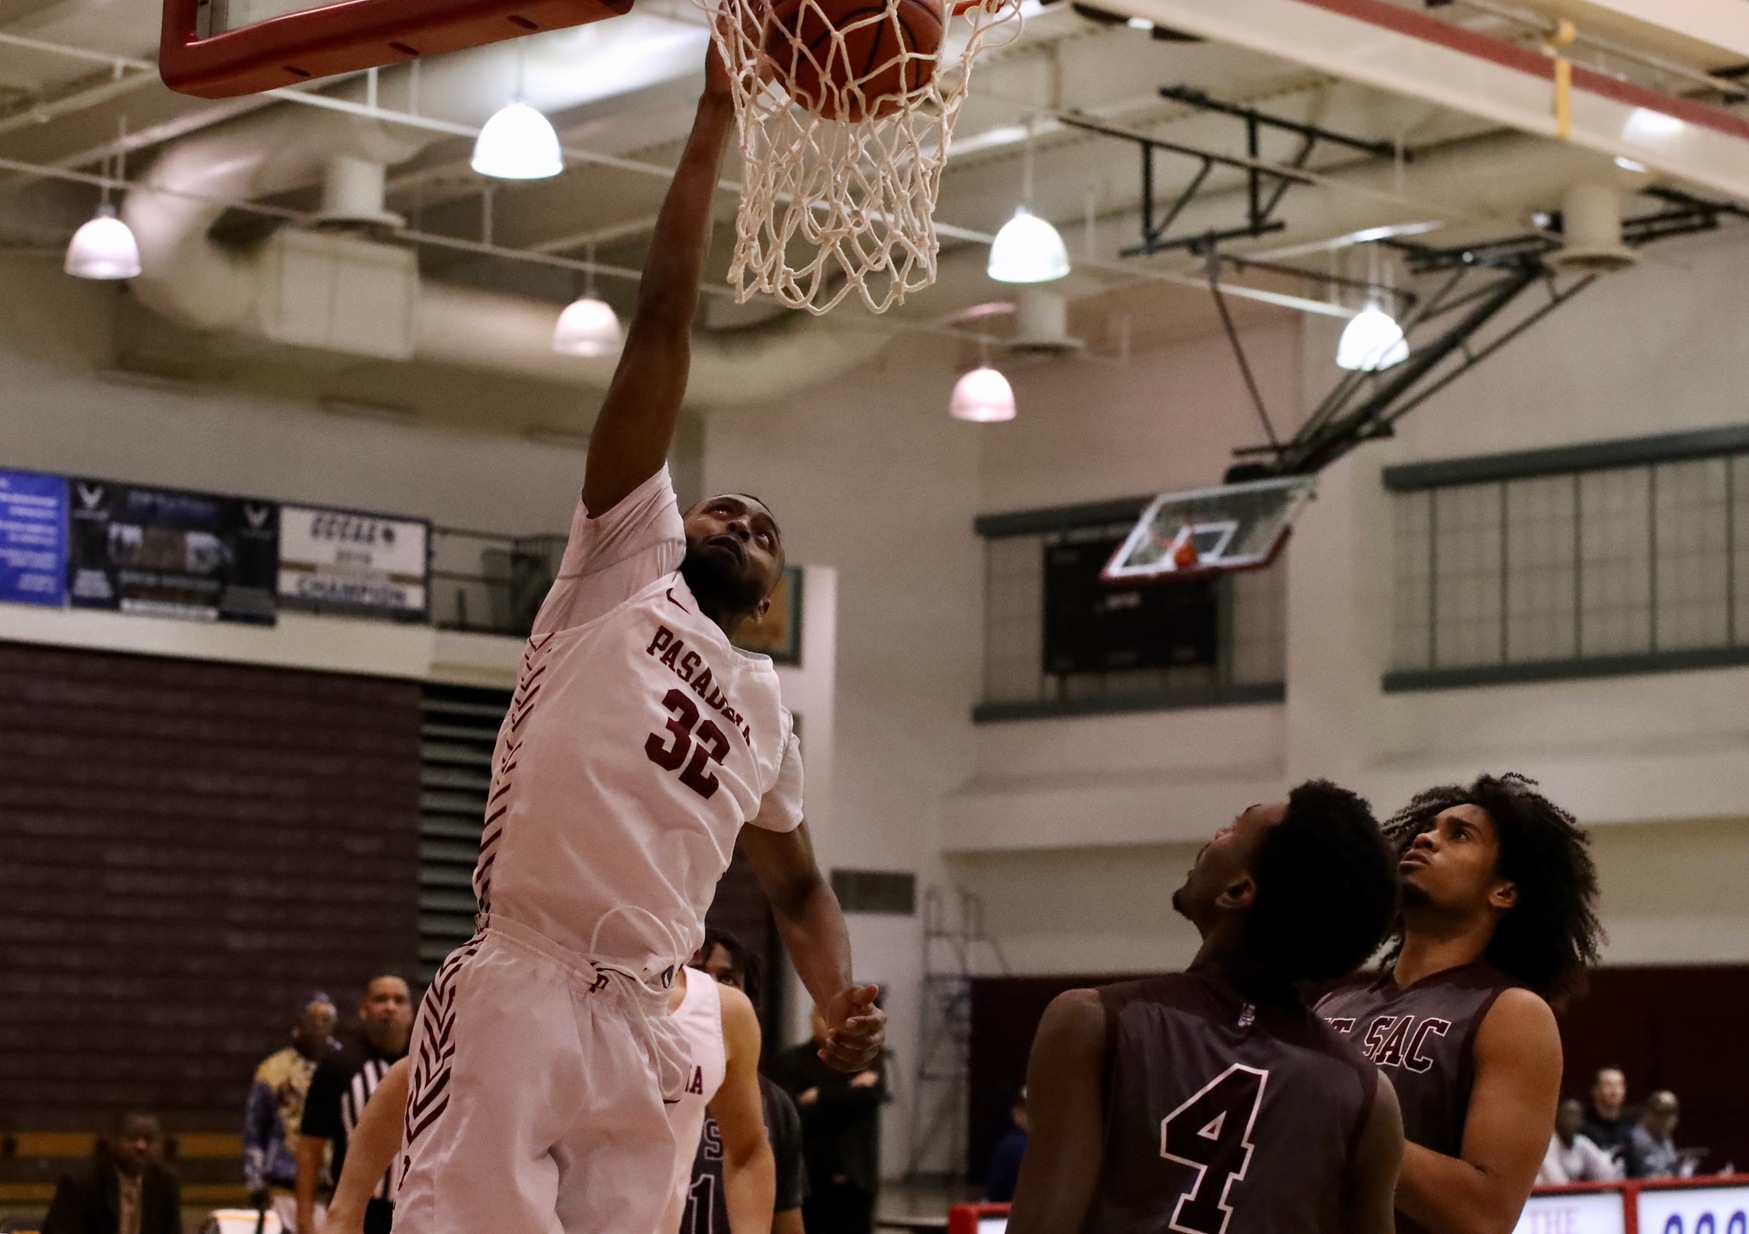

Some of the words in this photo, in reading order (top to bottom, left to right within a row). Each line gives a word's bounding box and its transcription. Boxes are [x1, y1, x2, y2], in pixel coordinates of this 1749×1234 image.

[644, 688, 731, 800] 32
[1362, 1015, 1452, 1074] SAC
[1160, 1062, 1269, 1234] 4
